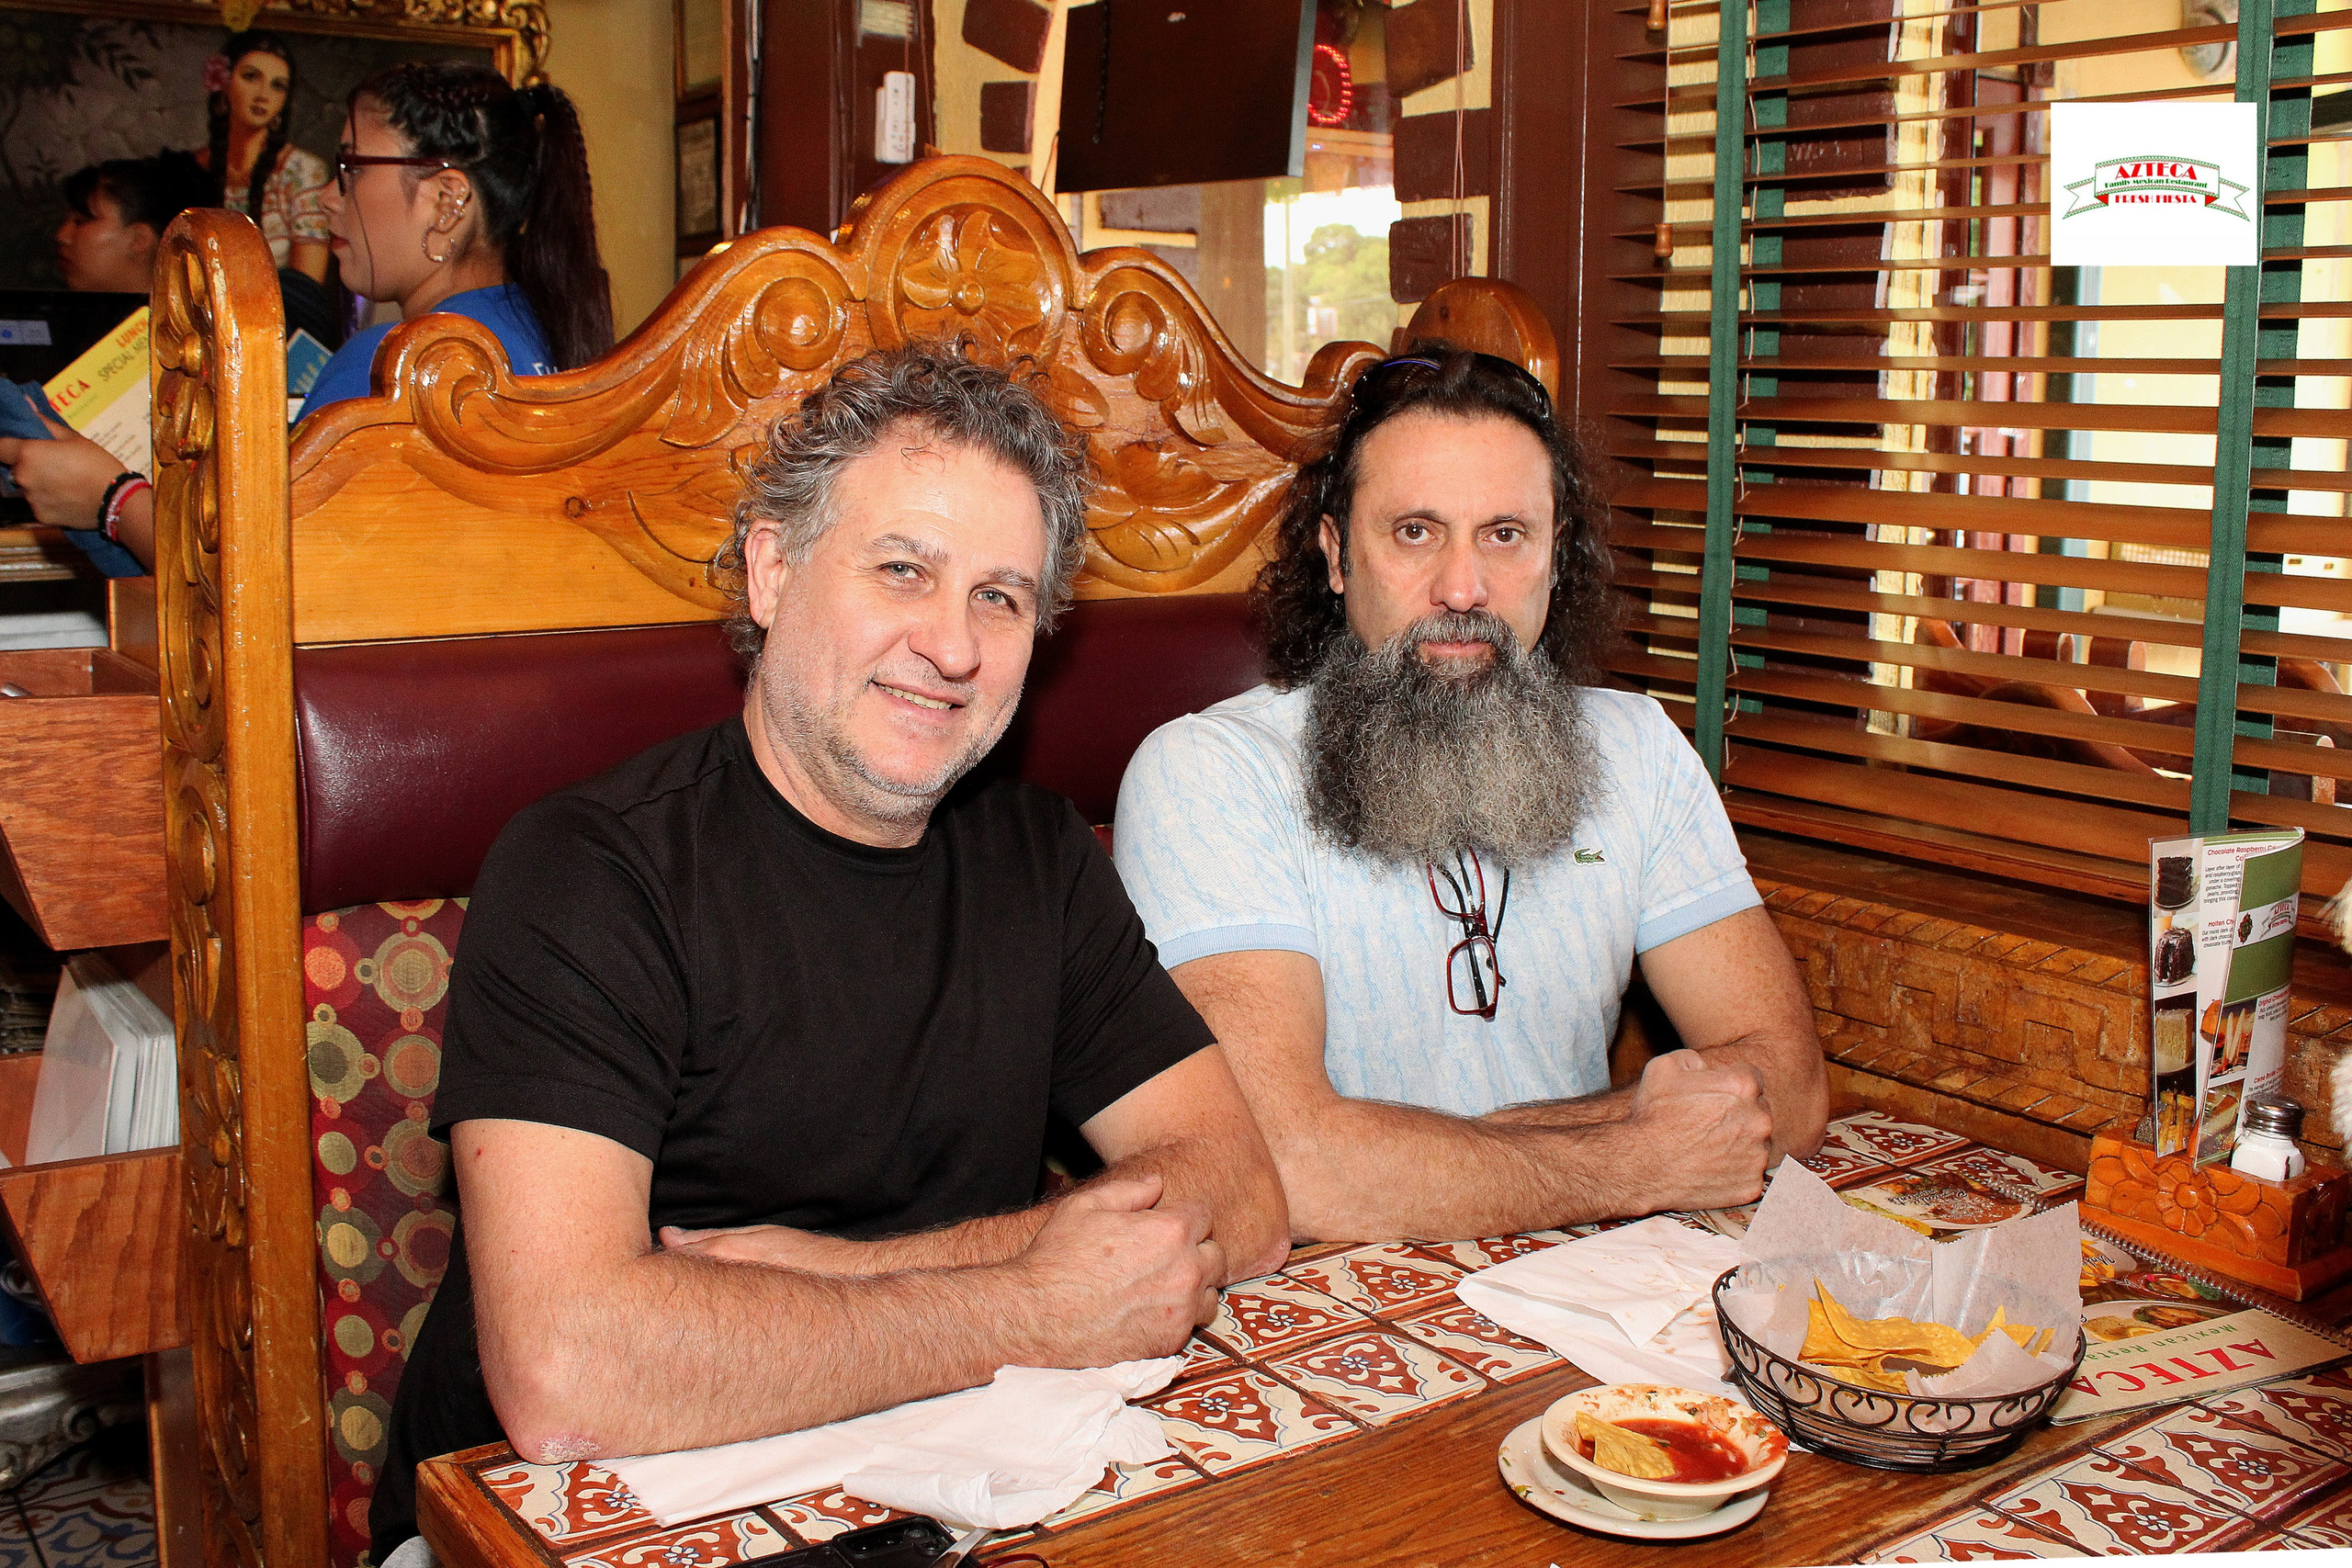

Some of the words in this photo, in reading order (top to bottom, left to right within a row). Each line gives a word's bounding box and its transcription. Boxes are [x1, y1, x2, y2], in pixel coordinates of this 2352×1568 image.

[48, 379, 91, 412] TECA
[2152, 1324, 2238, 1348] Mexican
[2083, 1344, 2149, 1362] Resta
[2066, 1338, 2277, 1398] AZTECA
